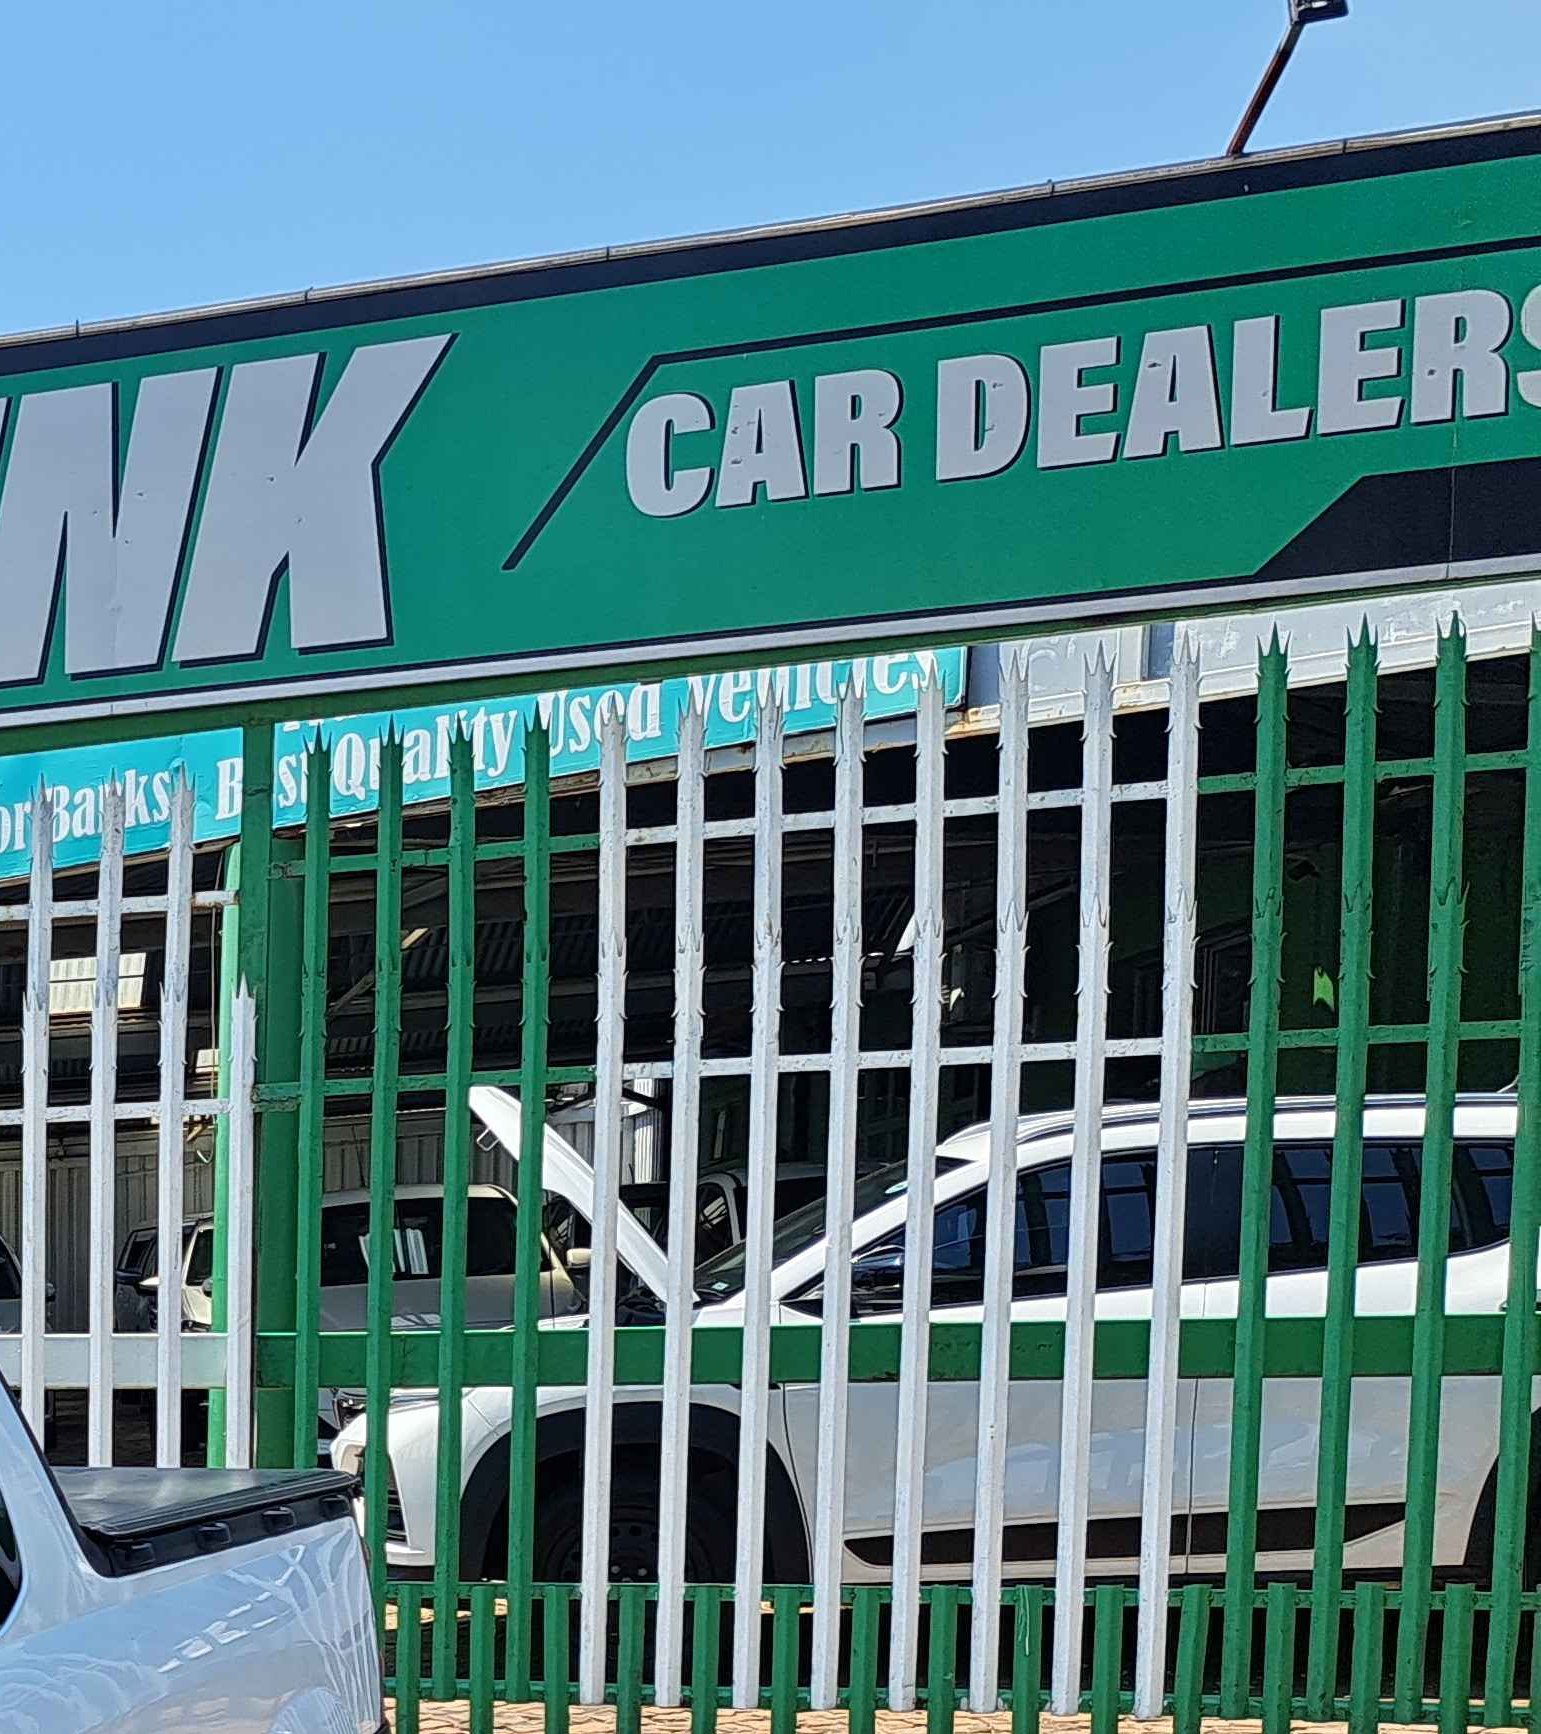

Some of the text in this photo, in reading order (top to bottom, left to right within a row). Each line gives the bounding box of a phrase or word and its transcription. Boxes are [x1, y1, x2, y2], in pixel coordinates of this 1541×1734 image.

[626, 289, 1541, 518] CAR DEALER
[52, 768, 174, 843] Baks
